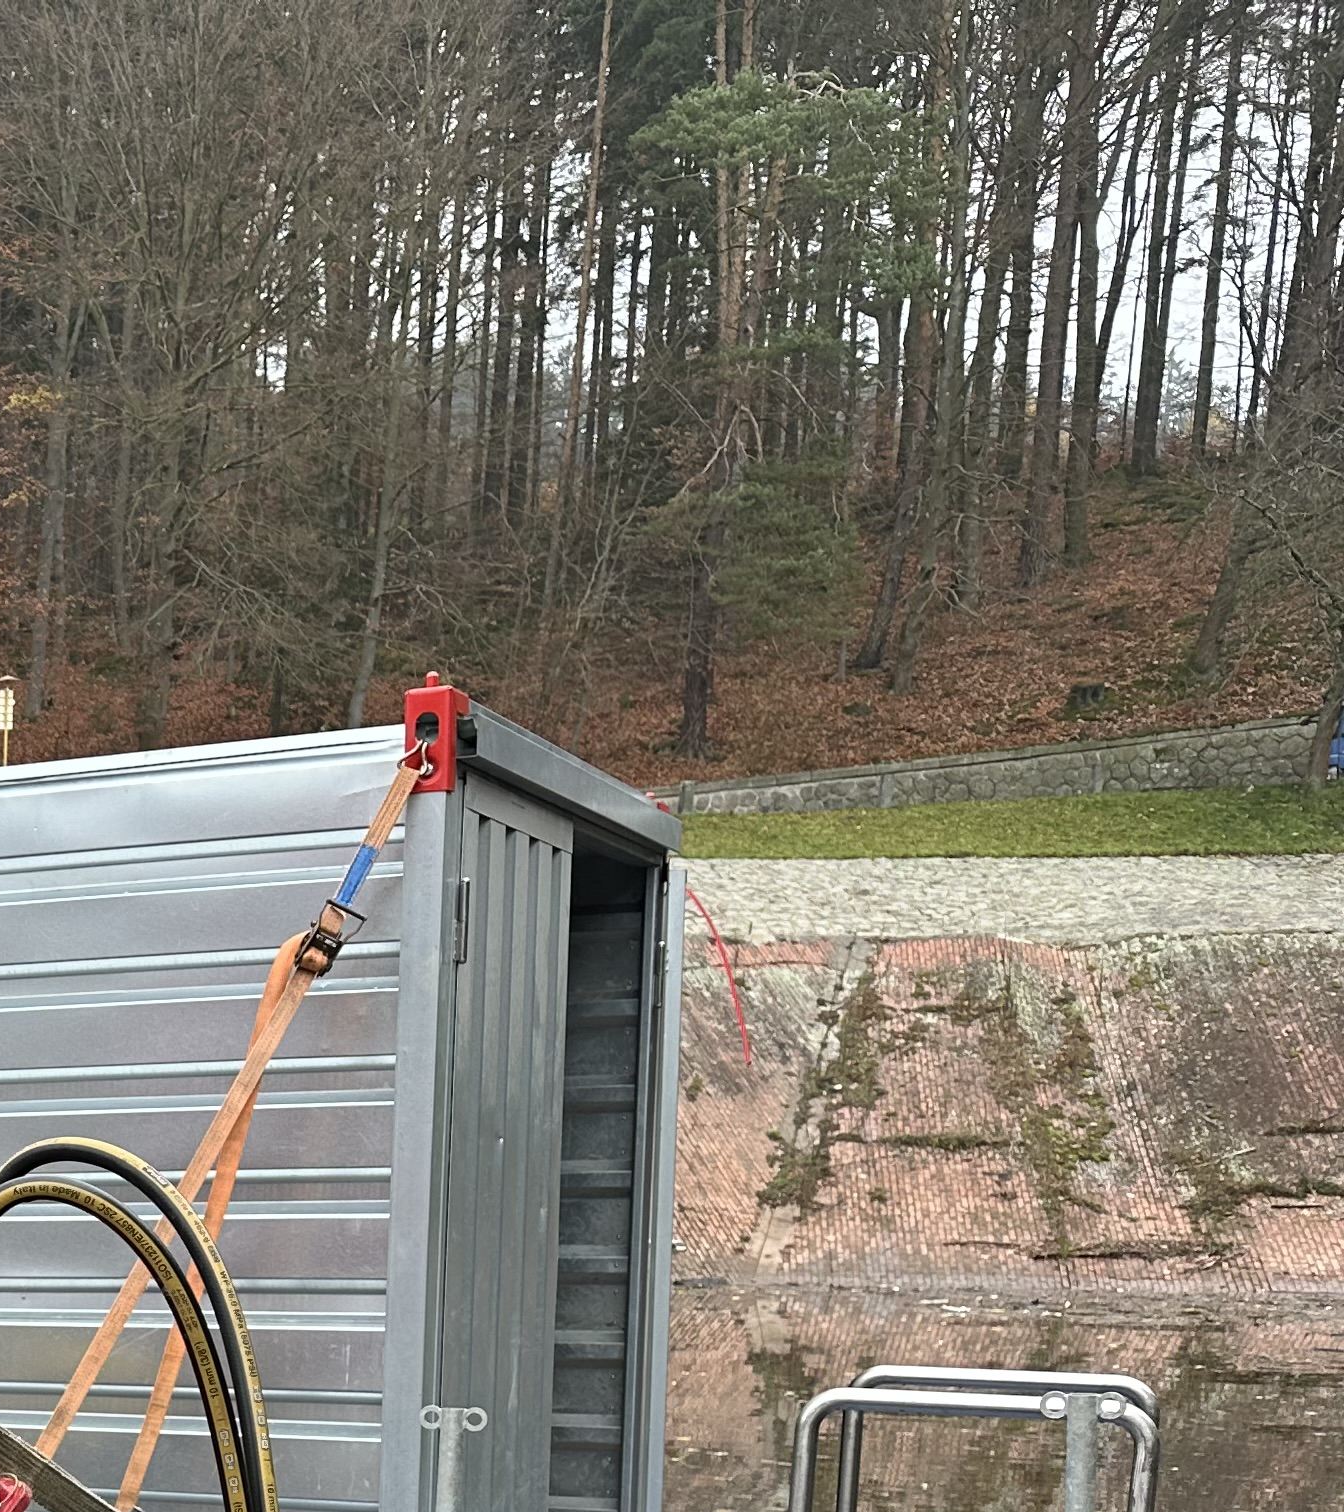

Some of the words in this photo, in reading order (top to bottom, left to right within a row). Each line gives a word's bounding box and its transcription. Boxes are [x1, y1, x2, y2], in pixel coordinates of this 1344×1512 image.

[13, 1185, 36, 1196] Italy
[39, 1185, 49, 1193] in
[52, 1185, 81, 1200] Made
[84, 1195, 96, 1206] 10
[96, 1203, 118, 1219] 2SC
[116, 1217, 173, 1281] ISO11237/EN857
[205, 1367, 216, 1386] mm
[208, 1388, 219, 1399] 10
